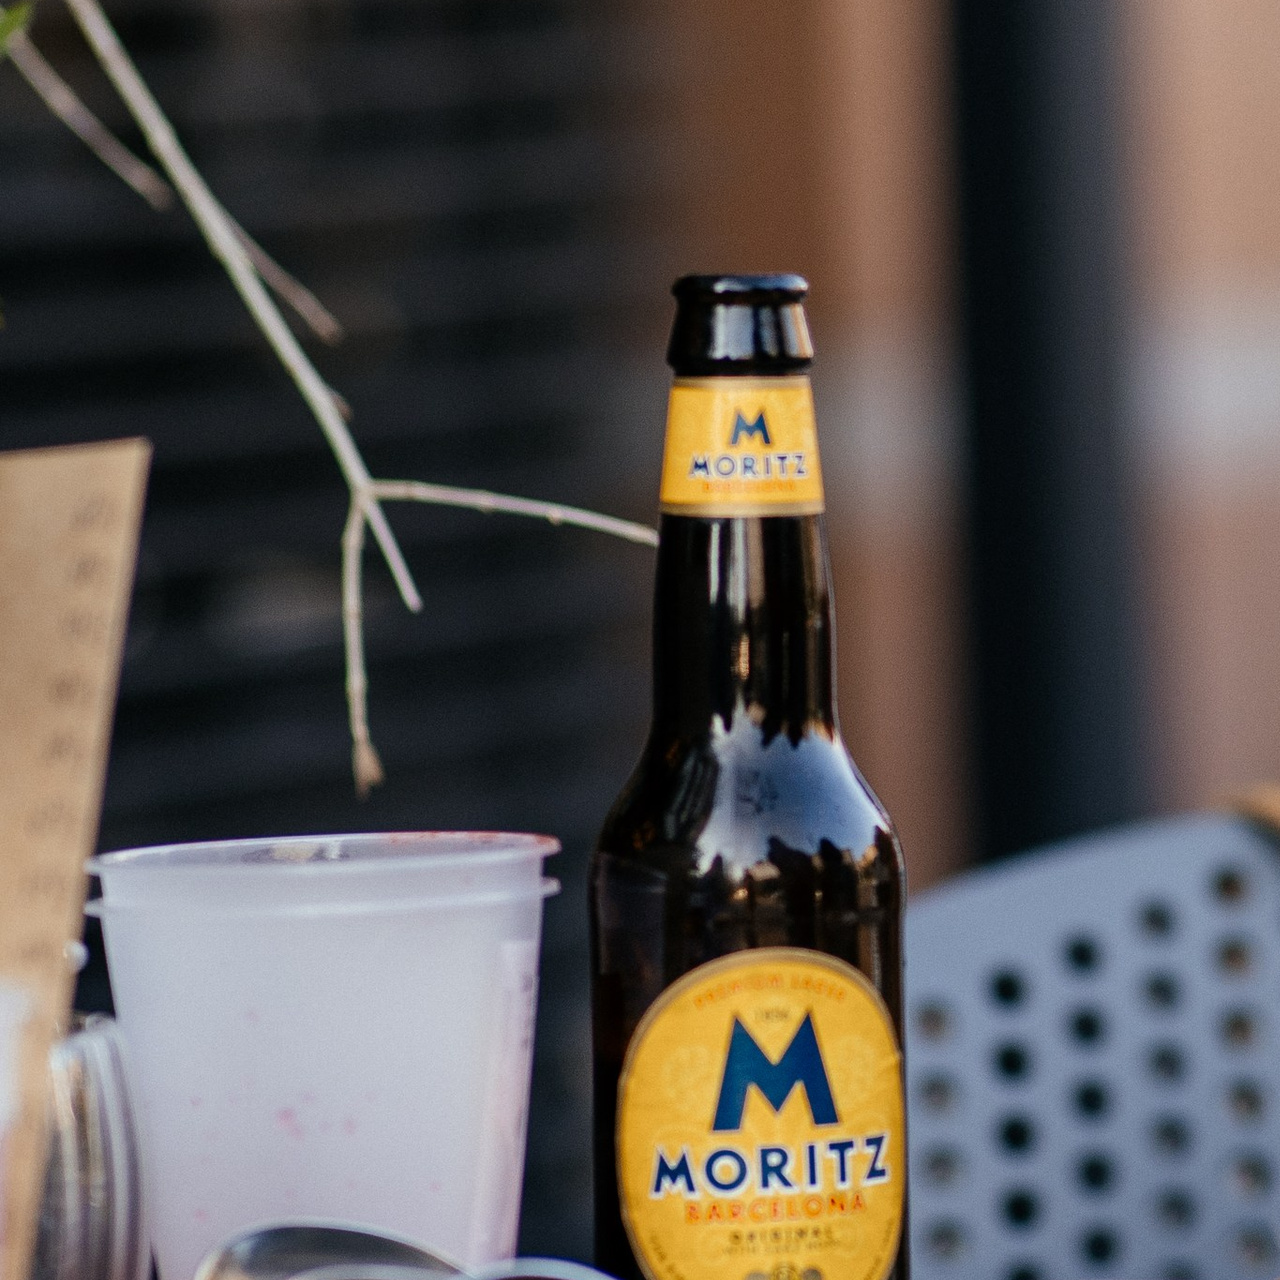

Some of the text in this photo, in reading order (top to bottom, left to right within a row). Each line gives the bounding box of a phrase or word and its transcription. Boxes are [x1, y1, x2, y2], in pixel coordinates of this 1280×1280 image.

[730, 411, 771, 445] M
[690, 454, 807, 477] MORITZ
[712, 1012, 840, 1131] M
[652, 1135, 888, 1195] MORITZ
[684, 1193, 867, 1224] BARCELONA
